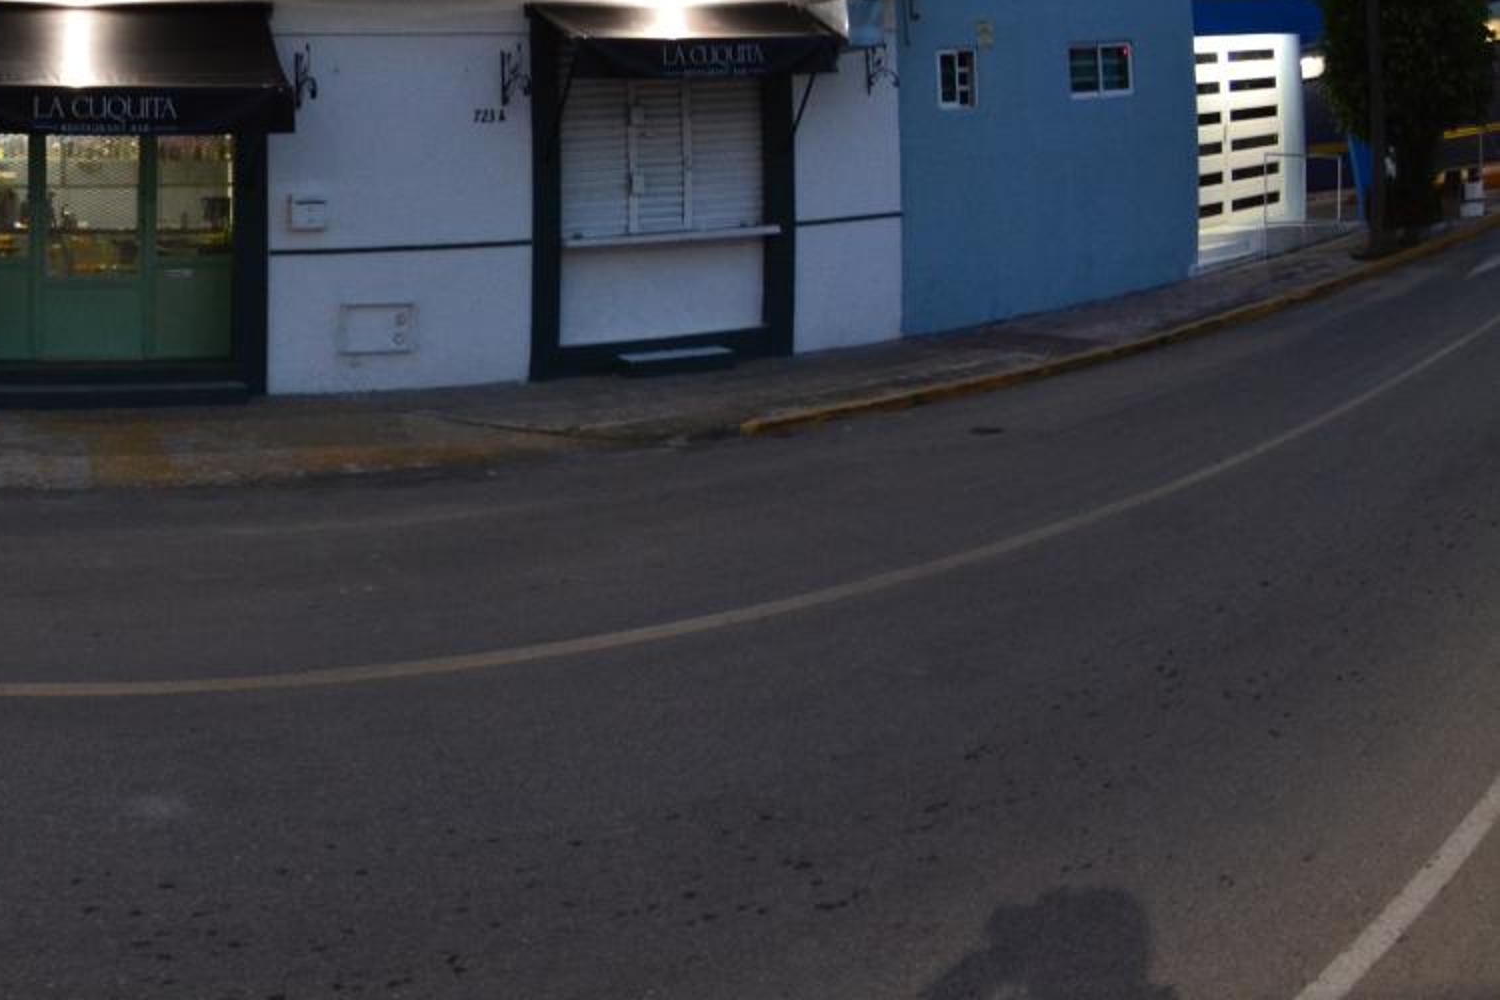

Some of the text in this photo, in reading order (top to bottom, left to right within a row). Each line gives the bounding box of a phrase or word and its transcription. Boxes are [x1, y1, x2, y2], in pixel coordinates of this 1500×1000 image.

[663, 44, 686, 65] LA
[34, 96, 178, 123] LA CUQUITA
